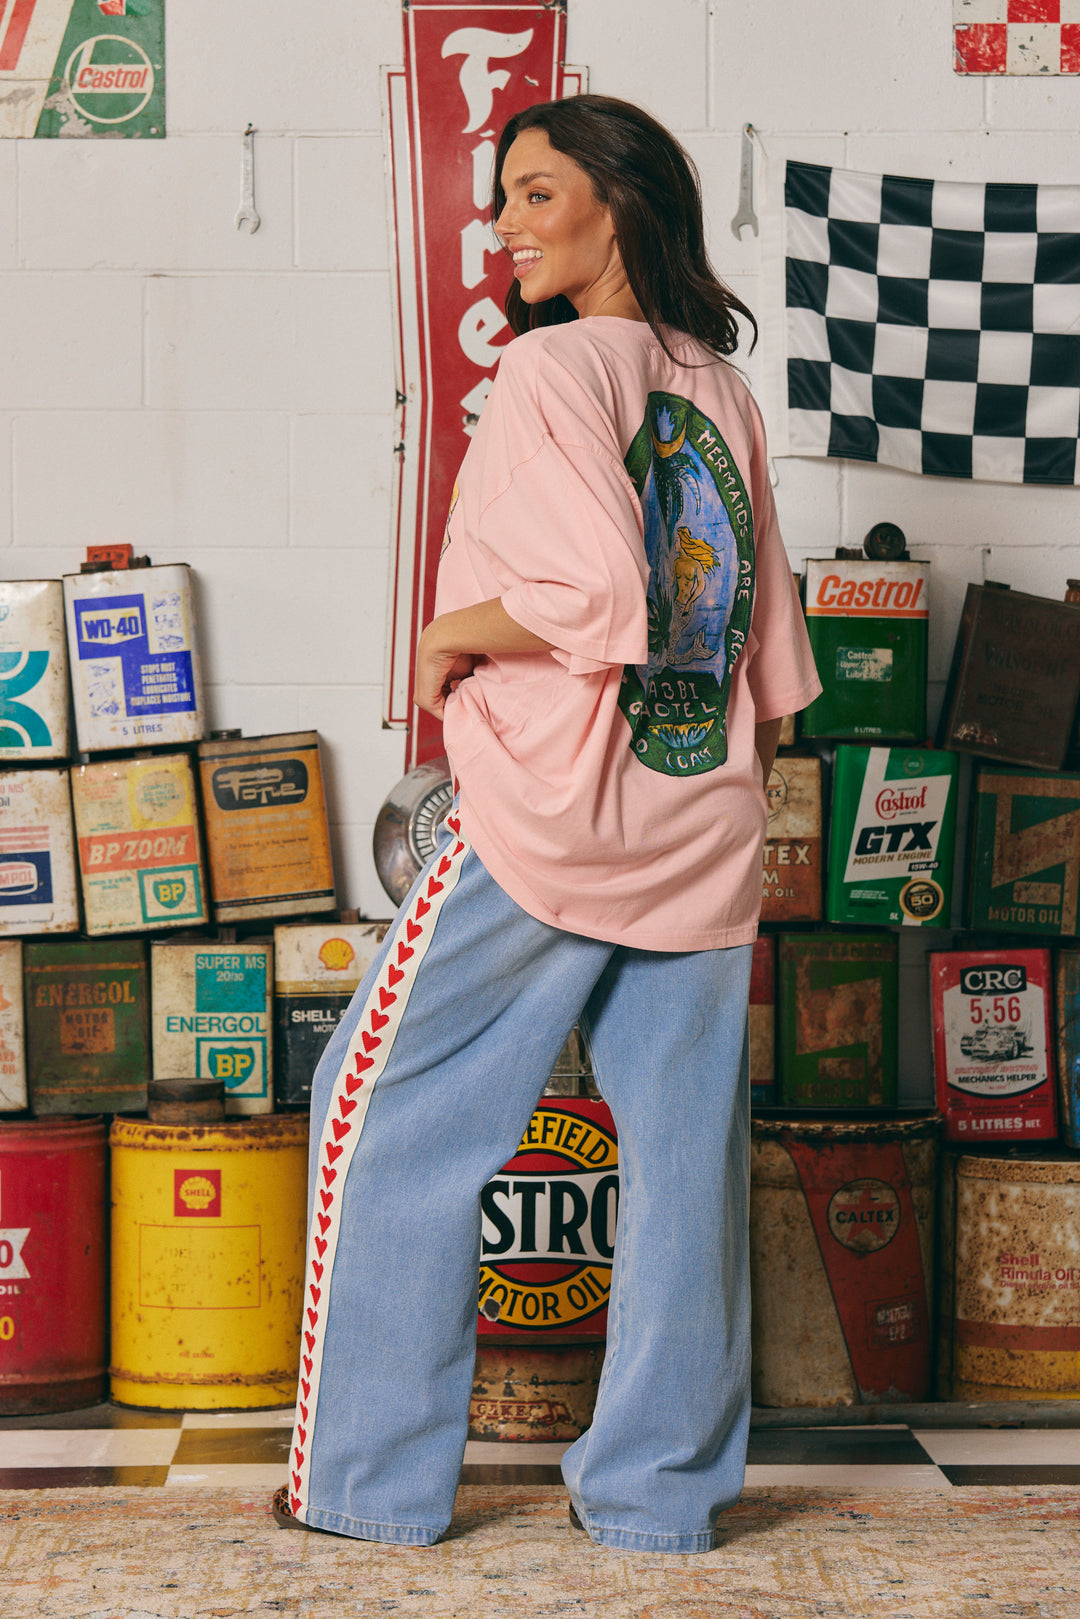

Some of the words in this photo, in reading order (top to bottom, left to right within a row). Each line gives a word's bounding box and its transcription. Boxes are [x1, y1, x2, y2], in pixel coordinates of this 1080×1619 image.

[73, 67, 148, 88] Castrol
[697, 429, 749, 538] MERMAIDS
[738, 560, 751, 600] ARE
[816, 574, 924, 609] Castrol
[84, 615, 139, 640] WD-40
[122, 726, 128, 735] 5
[133, 723, 163, 735] LITRES
[666, 746, 714, 769] COAST
[875, 785, 928, 821] Castrol
[855, 821, 938, 855] GTX
[88, 842, 121, 866] BP
[122, 834, 189, 862] ZOOM
[853, 854, 895, 866] MODERN
[897, 850, 933, 861] ENGINE
[911, 862, 940, 871] 15W-40
[158, 883, 184, 902] BP
[775, 888, 796, 897] OIL
[911, 894, 935, 907] 50
[988, 905, 1036, 923] MOTOR
[1041, 911, 1061, 924] OIL
[196, 957, 241, 969] SUPER
[245, 957, 266, 969] MS
[216, 971, 245, 982] 20/30
[964, 968, 1023, 990] CRC
[35, 981, 136, 1007] ENERGOL
[66, 1012, 108, 1025] MOTOR
[291, 1009, 336, 1023] SHELL
[77, 1026, 98, 1039] OIL
[167, 1016, 267, 1033] ENERGOL
[215, 1054, 251, 1077] BP
[958, 1074, 1005, 1084] MECHANICS
[1006, 1073, 1036, 1082] HELPER
[958, 1120, 968, 1131] 5
[971, 1117, 1023, 1130] LITRES
[520, 1115, 609, 1164] EFIELD
[185, 1189, 211, 1197] SHELL
[836, 1208, 894, 1224] CALTEX
[1001, 1253, 1039, 1266] Shell
[1001, 1267, 1051, 1280] Rimula
[1055, 1268, 1074, 1281] Oil
[567, 1271, 611, 1311] OIL
